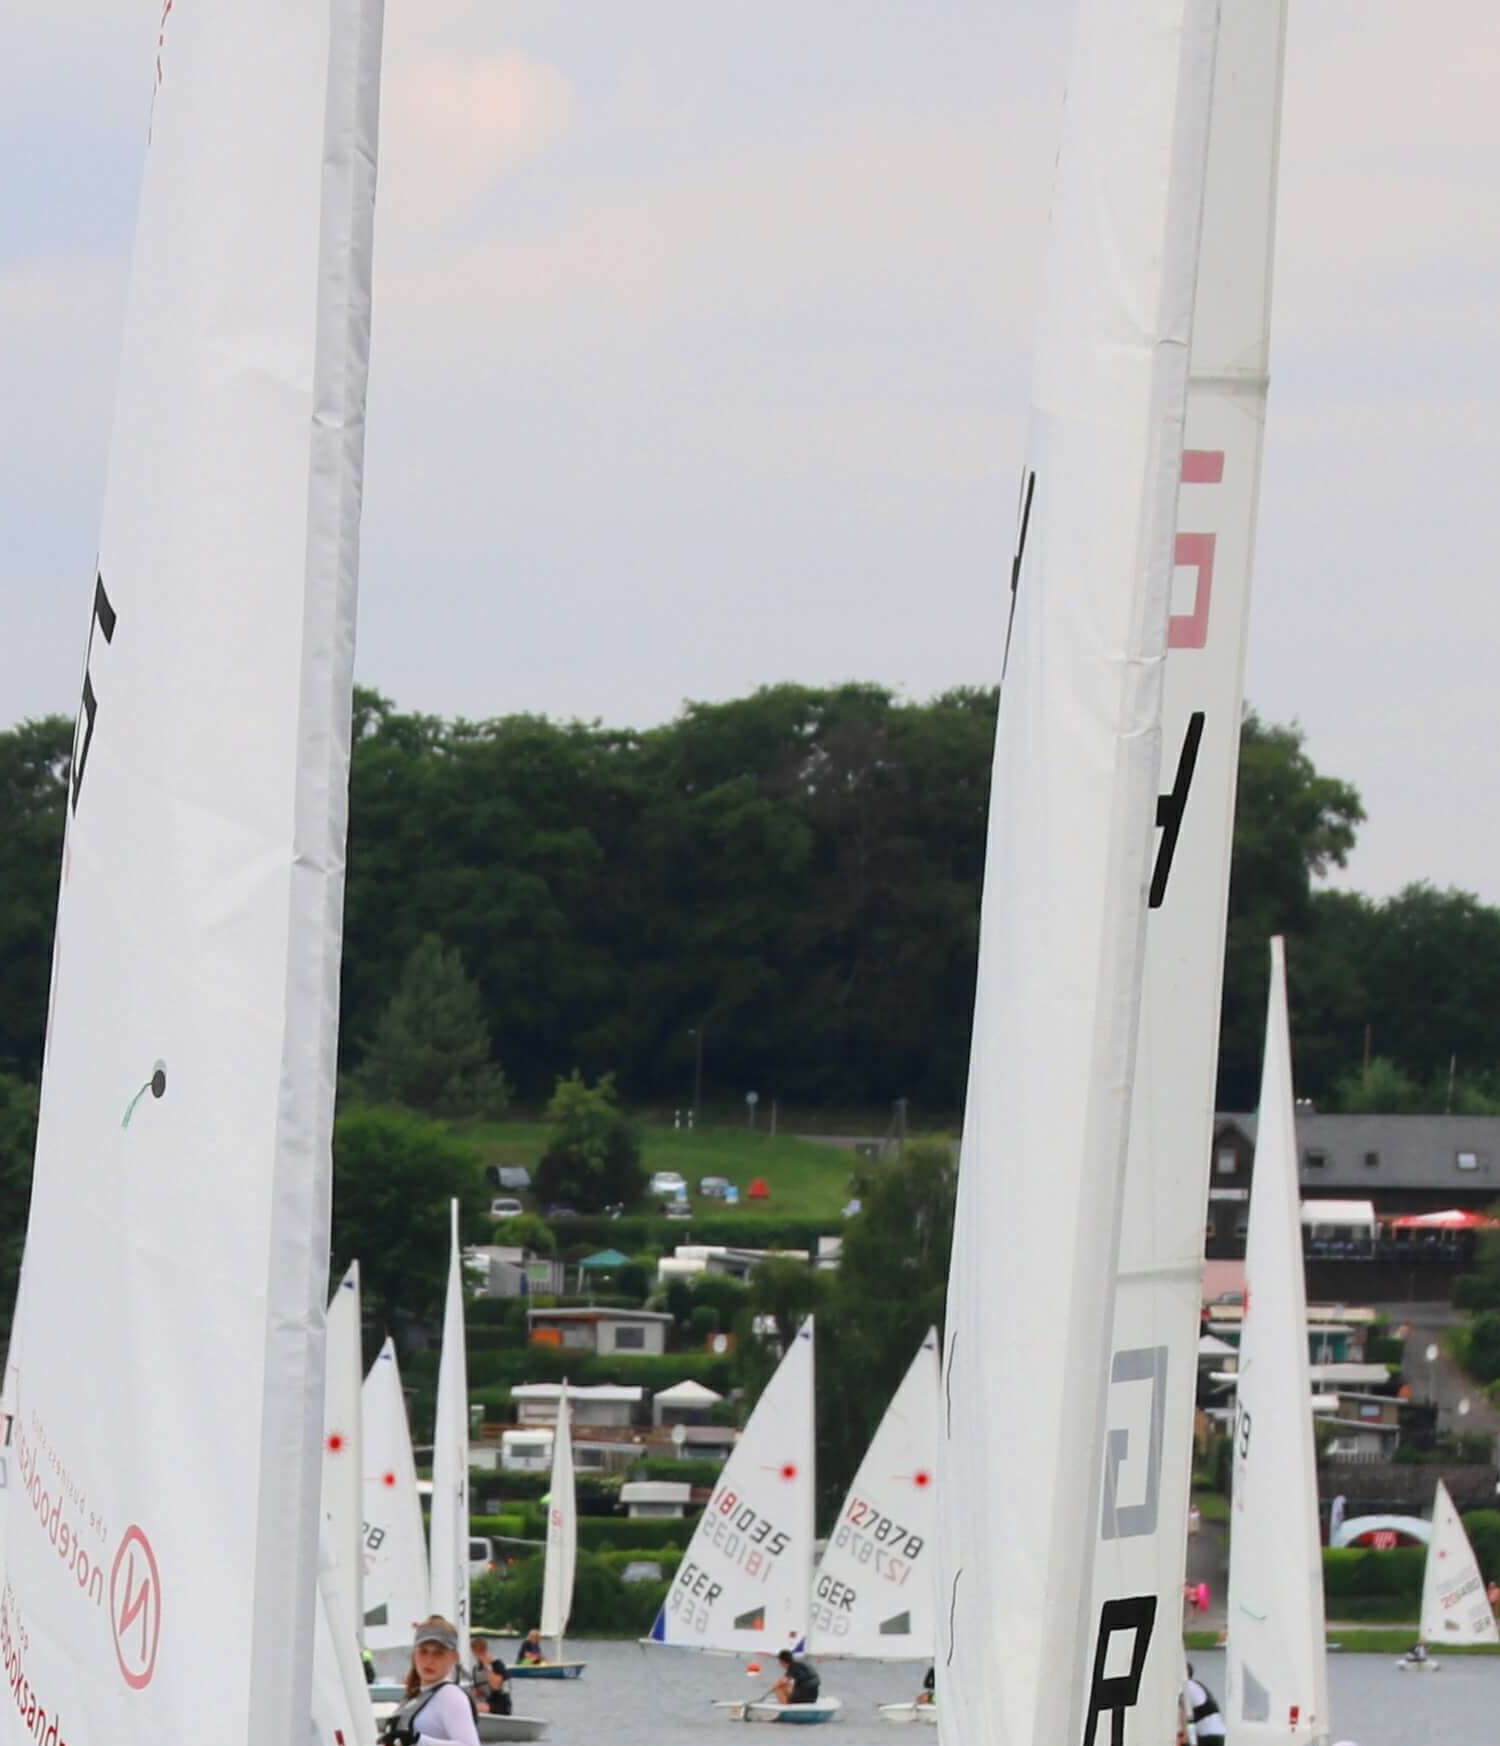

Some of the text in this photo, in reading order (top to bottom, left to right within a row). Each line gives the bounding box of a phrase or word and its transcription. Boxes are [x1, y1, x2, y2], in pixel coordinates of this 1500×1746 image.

[714, 1486, 791, 1556] 181035
[846, 1496, 925, 1561] 127878
[679, 1562, 723, 1607] GER
[815, 1574, 857, 1613] GER
